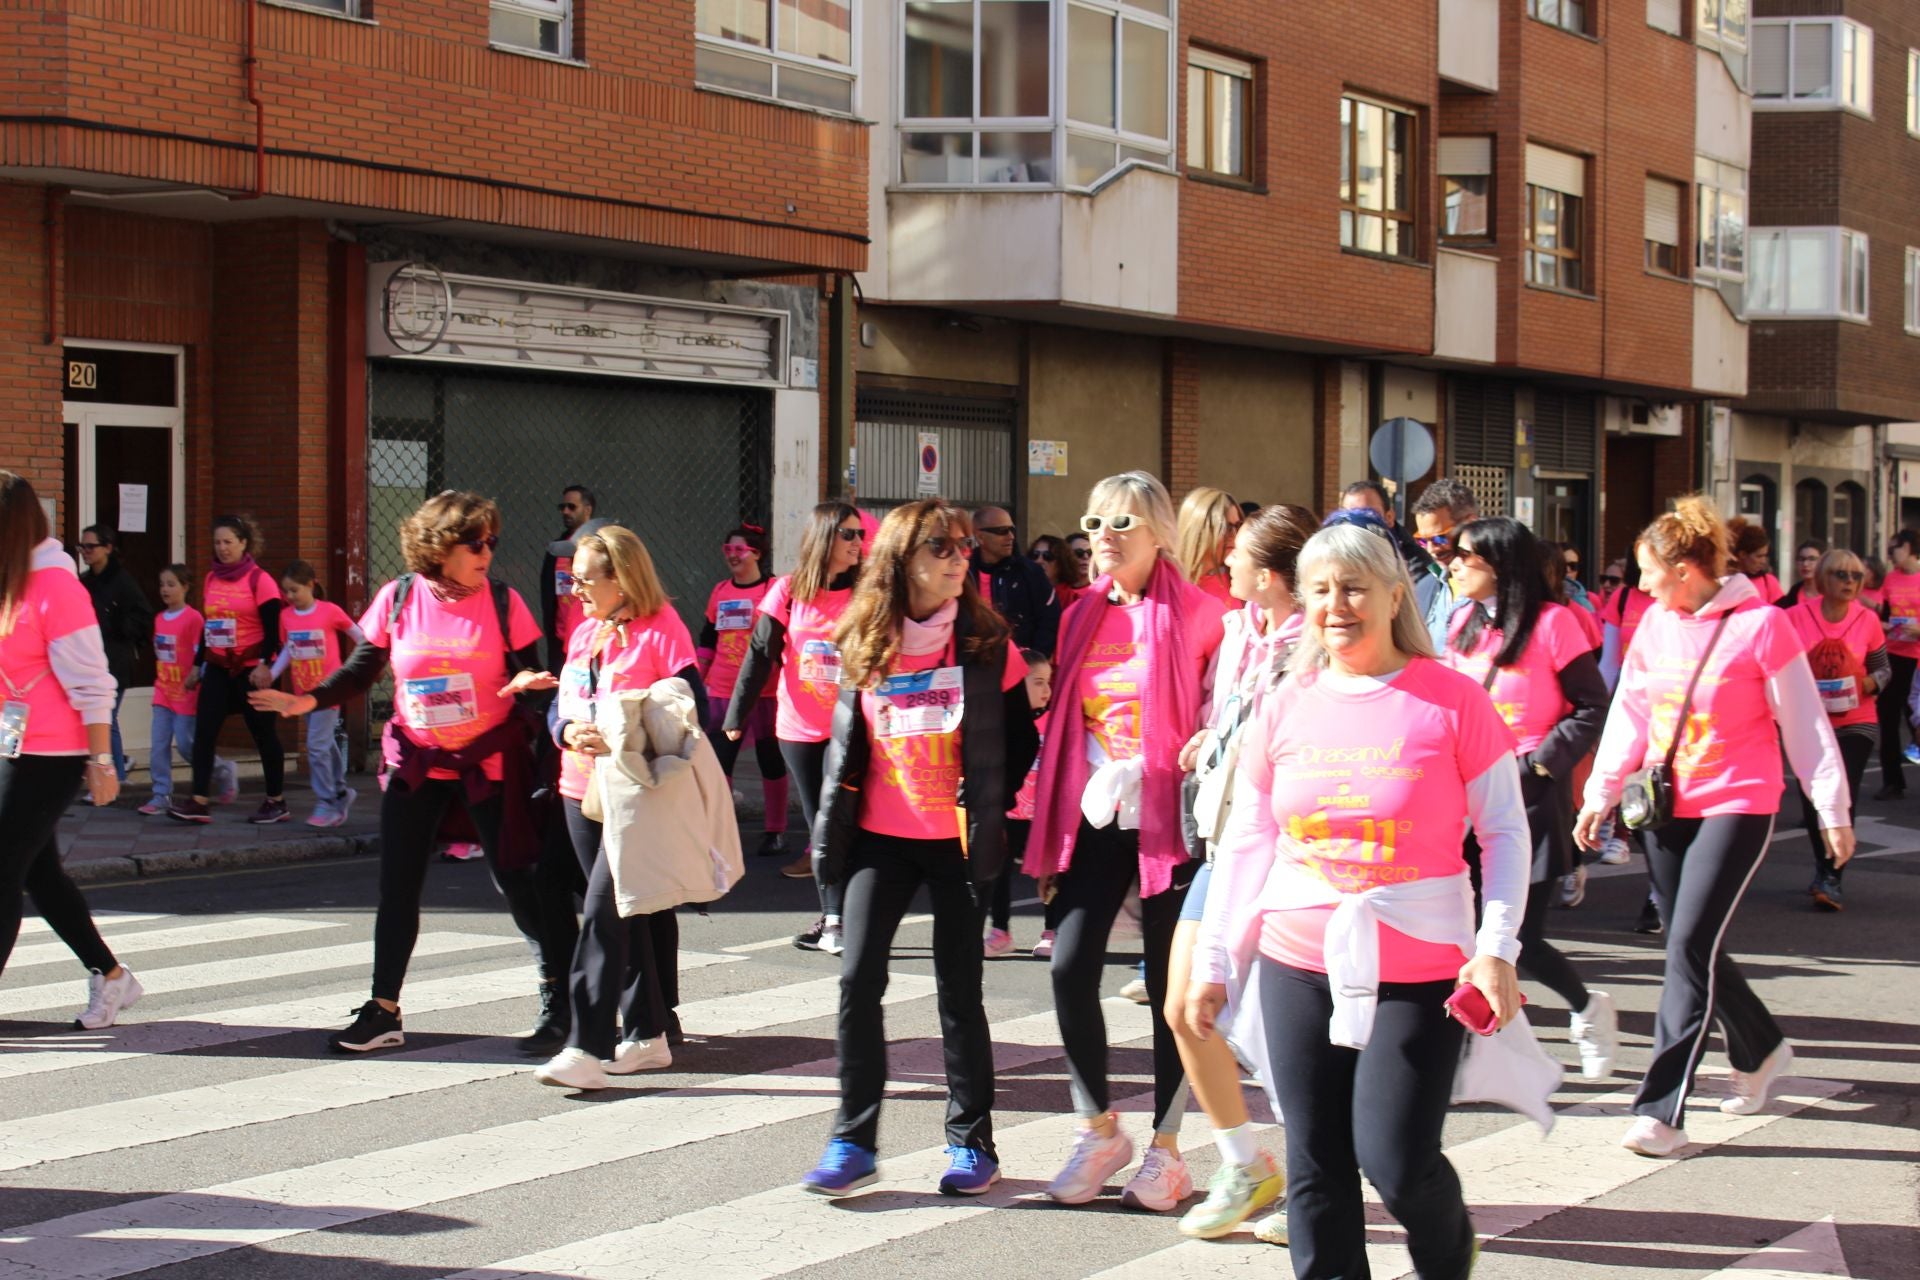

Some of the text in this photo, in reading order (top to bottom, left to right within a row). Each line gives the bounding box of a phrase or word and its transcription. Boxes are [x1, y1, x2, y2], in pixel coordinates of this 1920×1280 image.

[71, 364, 94, 386] 20
[906, 690, 950, 708] 2889
[1299, 736, 1406, 765] Drasanvi
[1330, 858, 1420, 882] Carrera
